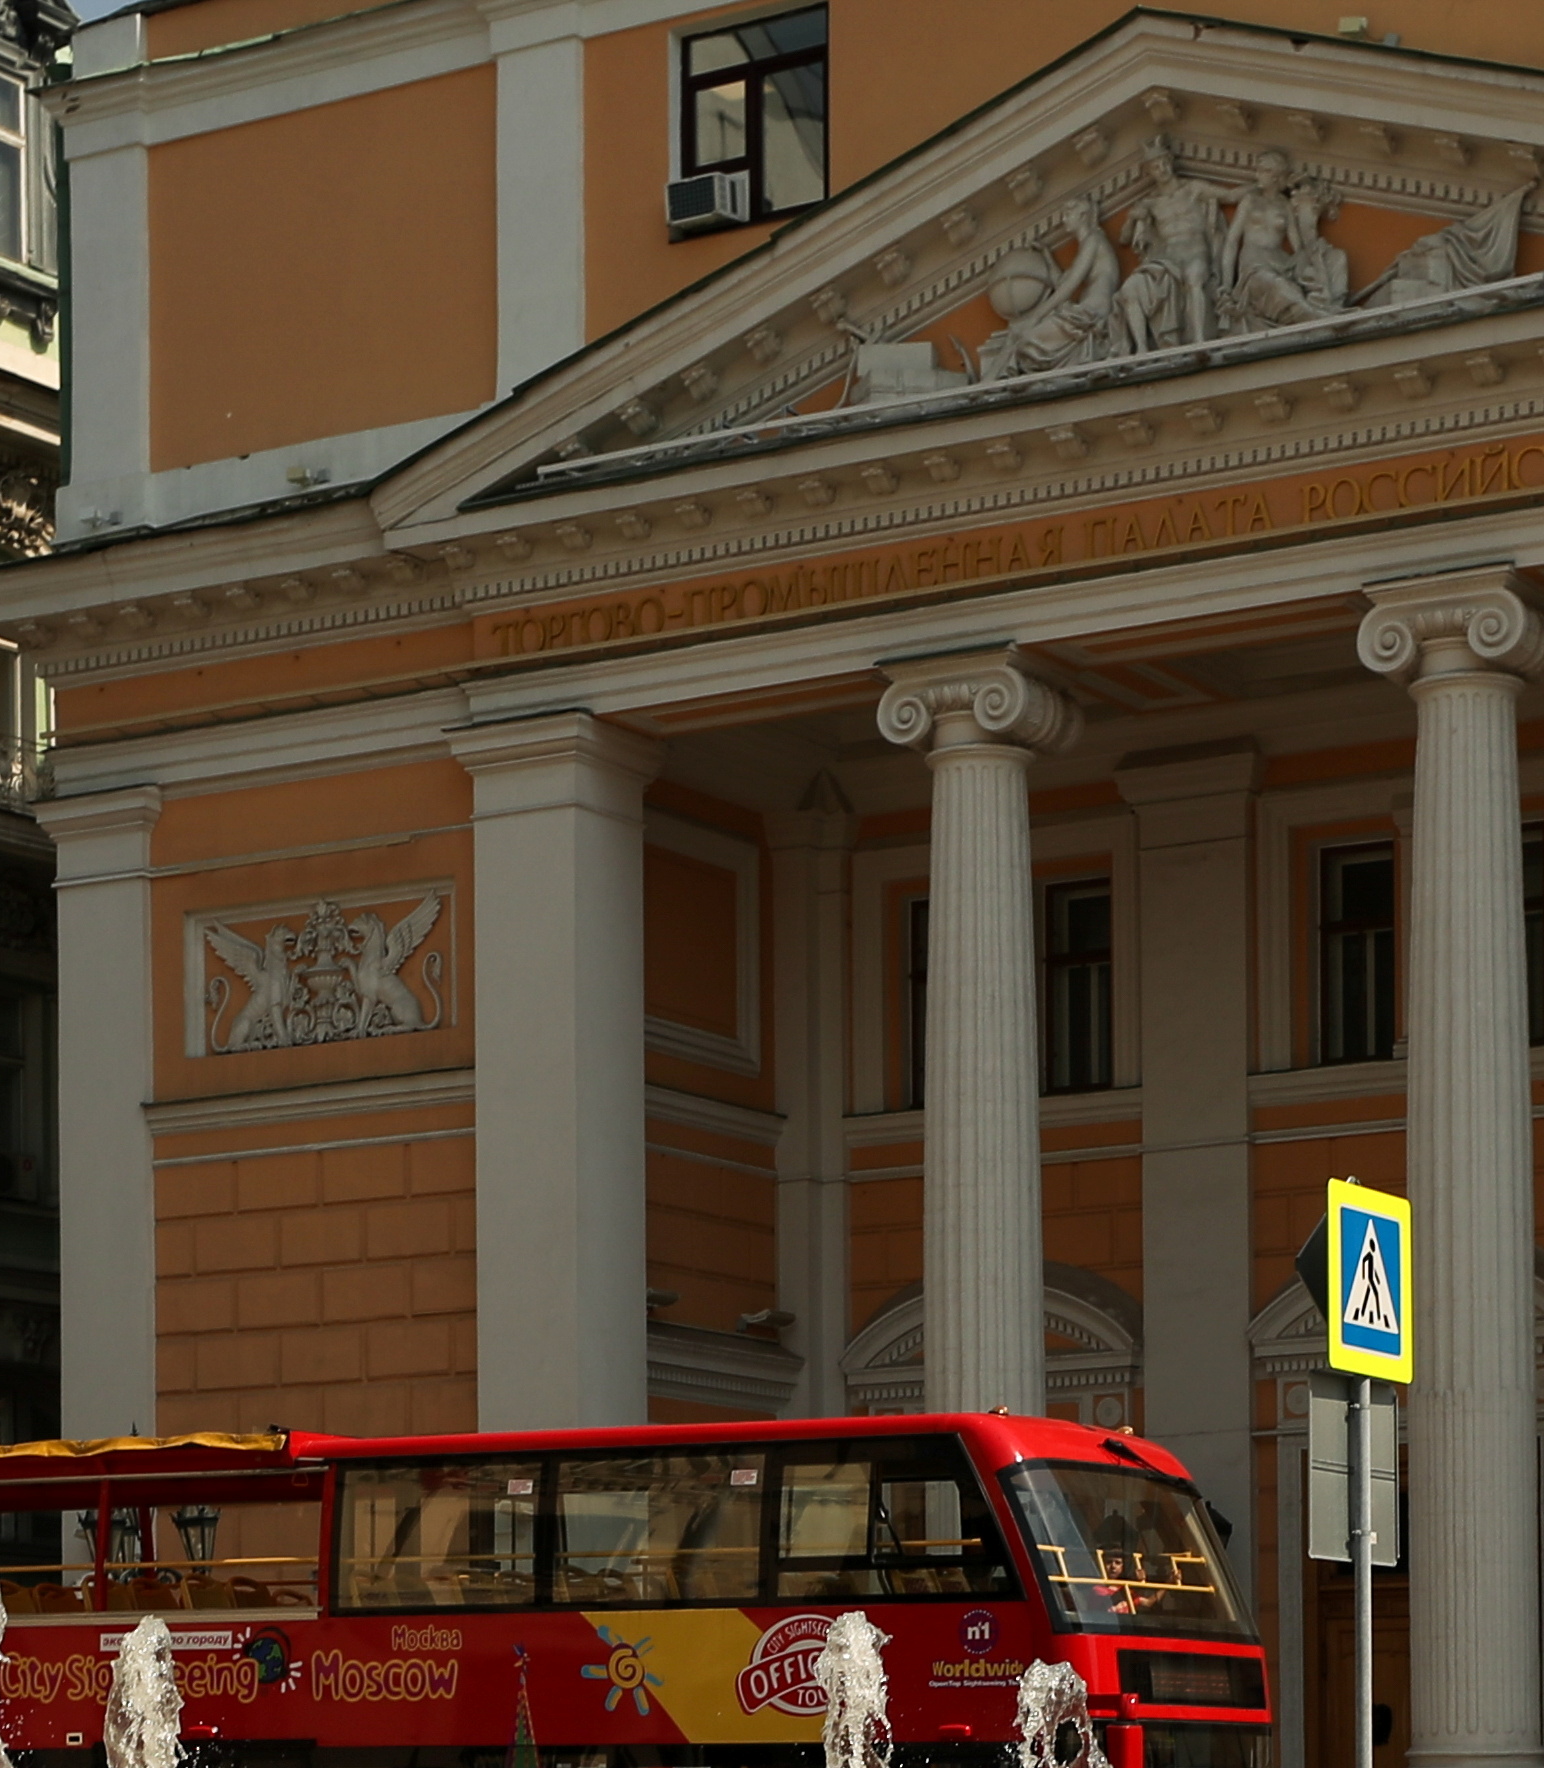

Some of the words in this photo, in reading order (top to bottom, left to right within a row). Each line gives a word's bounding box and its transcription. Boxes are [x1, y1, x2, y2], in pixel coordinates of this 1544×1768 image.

[490, 523, 1063, 658] ТОРГОВО-ПРОМЫШЛЕННАЯ
[1083, 497, 1275, 562] ПАЛАТА
[186, 1634, 230, 1647] городу
[767, 1632, 787, 1655] CITY
[785, 1620, 828, 1639] SIGHTSEE
[797, 1688, 829, 1707] TOU
